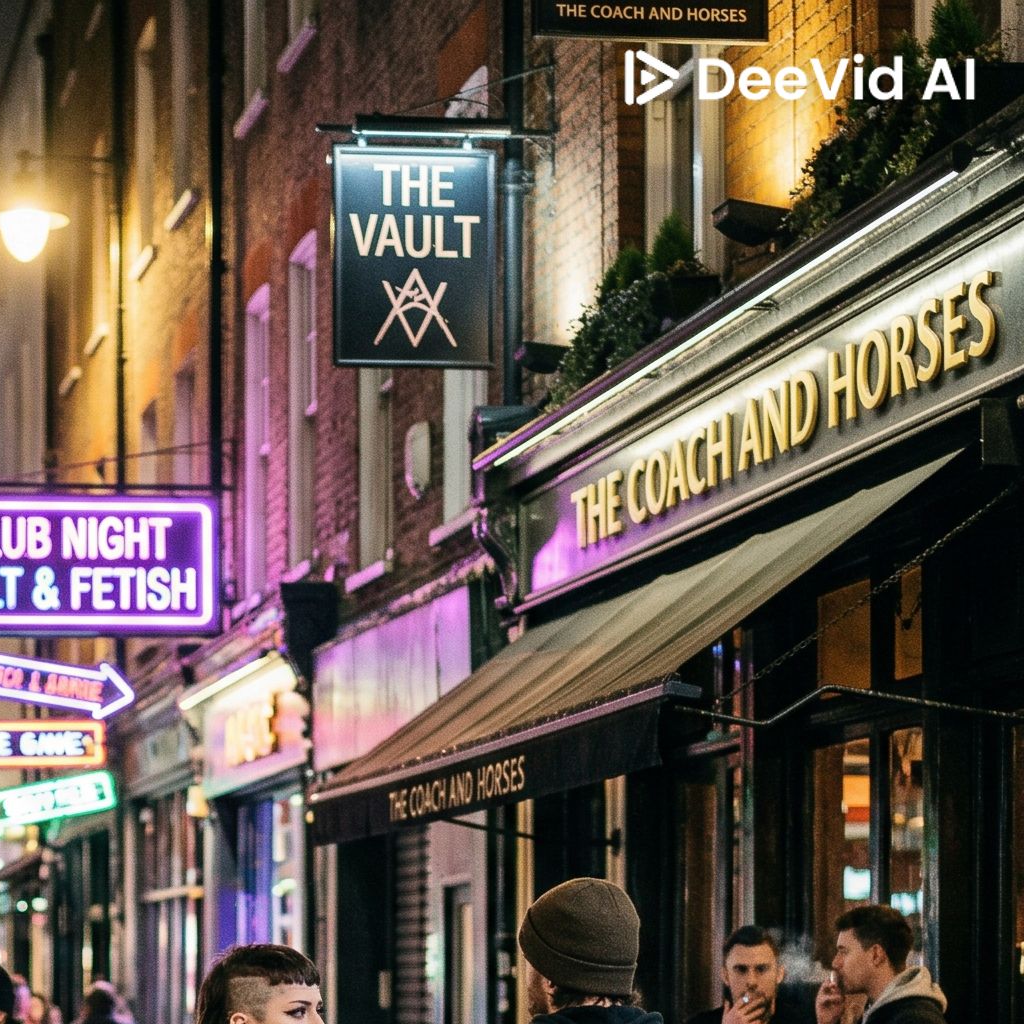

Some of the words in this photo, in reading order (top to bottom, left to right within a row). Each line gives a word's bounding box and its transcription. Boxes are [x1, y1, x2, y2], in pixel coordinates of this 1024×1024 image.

[556, 4, 587, 18] THE
[590, 4, 644, 20] COACH
[648, 6, 683, 21] AND
[687, 8, 747, 23] HORSES
[373, 163, 455, 208] THE
[349, 213, 481, 259] VAULT
[570, 468, 625, 549] THE
[626, 412, 735, 525] COACH
[738, 369, 819, 472] AND
[827, 270, 996, 429] HORSES
[61, 515, 173, 561] NIGHT
[32, 565, 61, 611] &
[70, 566, 197, 611] FETISH
[388, 788, 408, 822] THE
[409, 778, 447, 818] COACH
[448, 771, 474, 807] AND
[477, 755, 525, 800] HORSES
